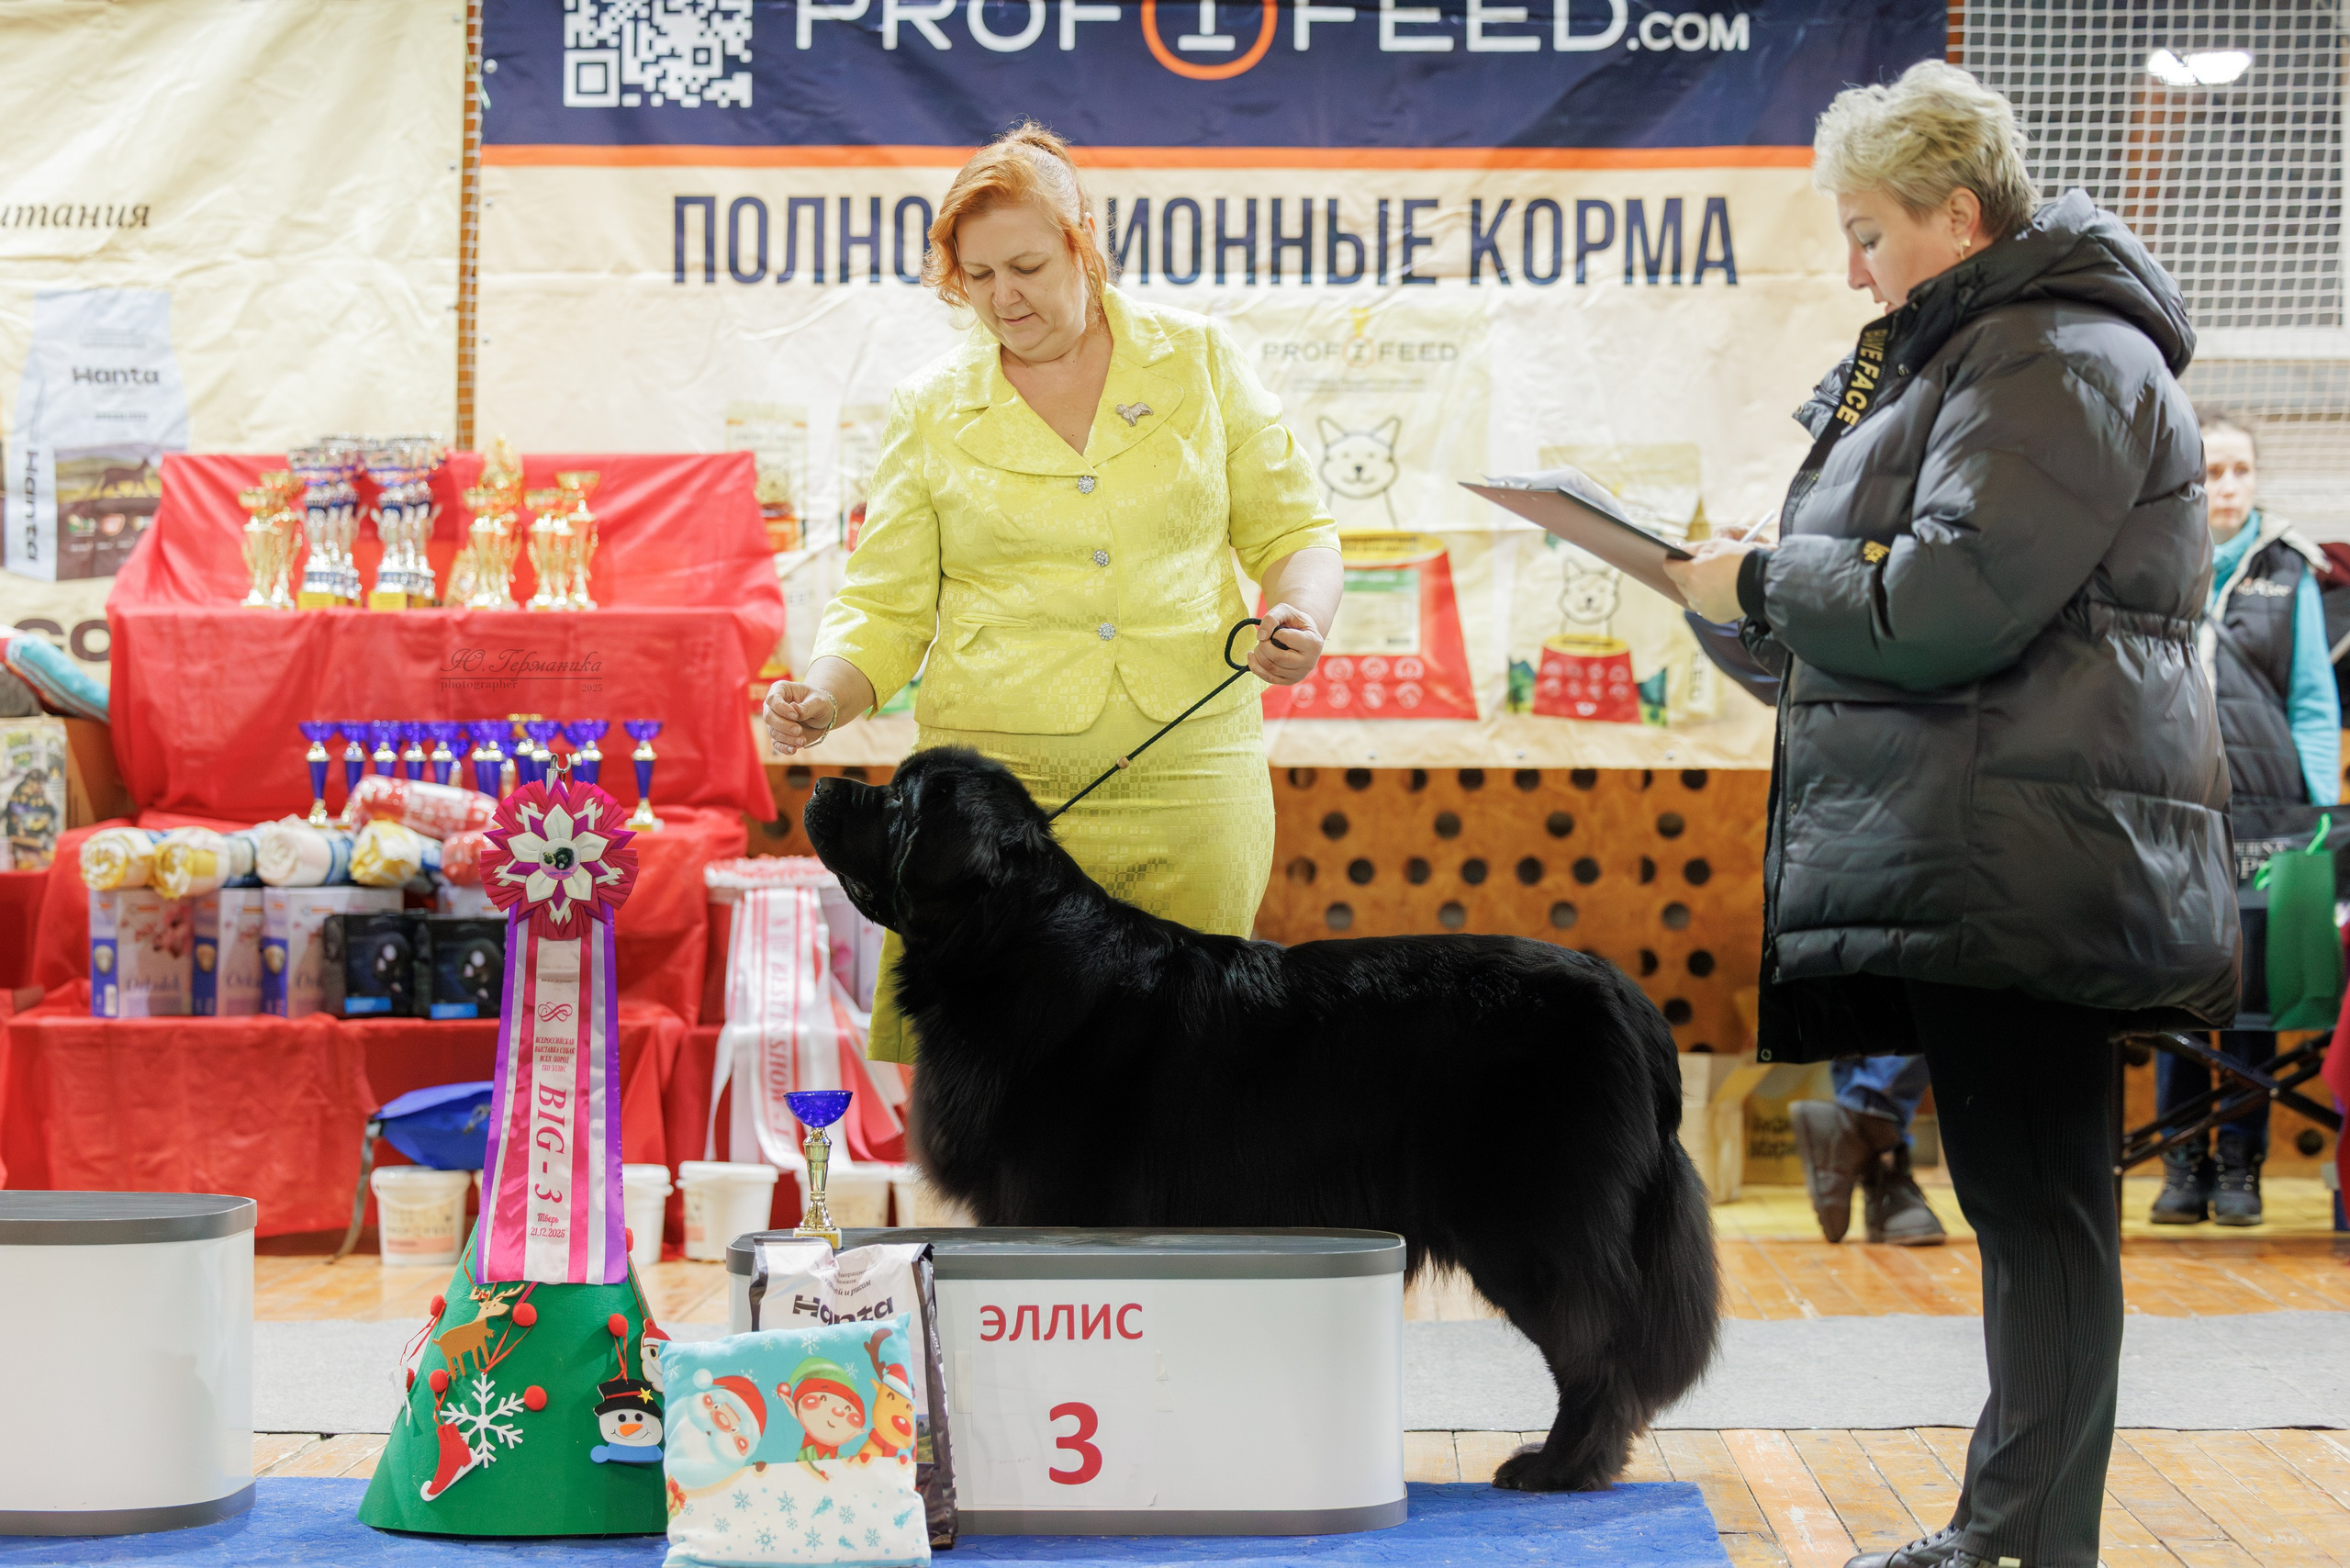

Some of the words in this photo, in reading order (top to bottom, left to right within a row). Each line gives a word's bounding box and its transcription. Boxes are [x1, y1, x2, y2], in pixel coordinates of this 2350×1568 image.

[1470, 196, 1739, 286] КОРМА
[73, 365, 160, 386] Hanta
[1836, 359, 1880, 428] FACE
[534, 1046, 559, 1054] ВЫСТАВКА
[535, 1036, 575, 1045] ВСЕРОССИЙСКАЯ
[535, 1081, 567, 1155] BIG
[530, 1226, 565, 1239] 21.12.2025
[537, 1213, 559, 1226] Тверь
[850, 1280, 871, 1297] рисом
[792, 1294, 894, 1326] Hanta
[979, 1303, 1144, 1342] ЭЛЛИС
[1048, 1401, 1103, 1485] 3
